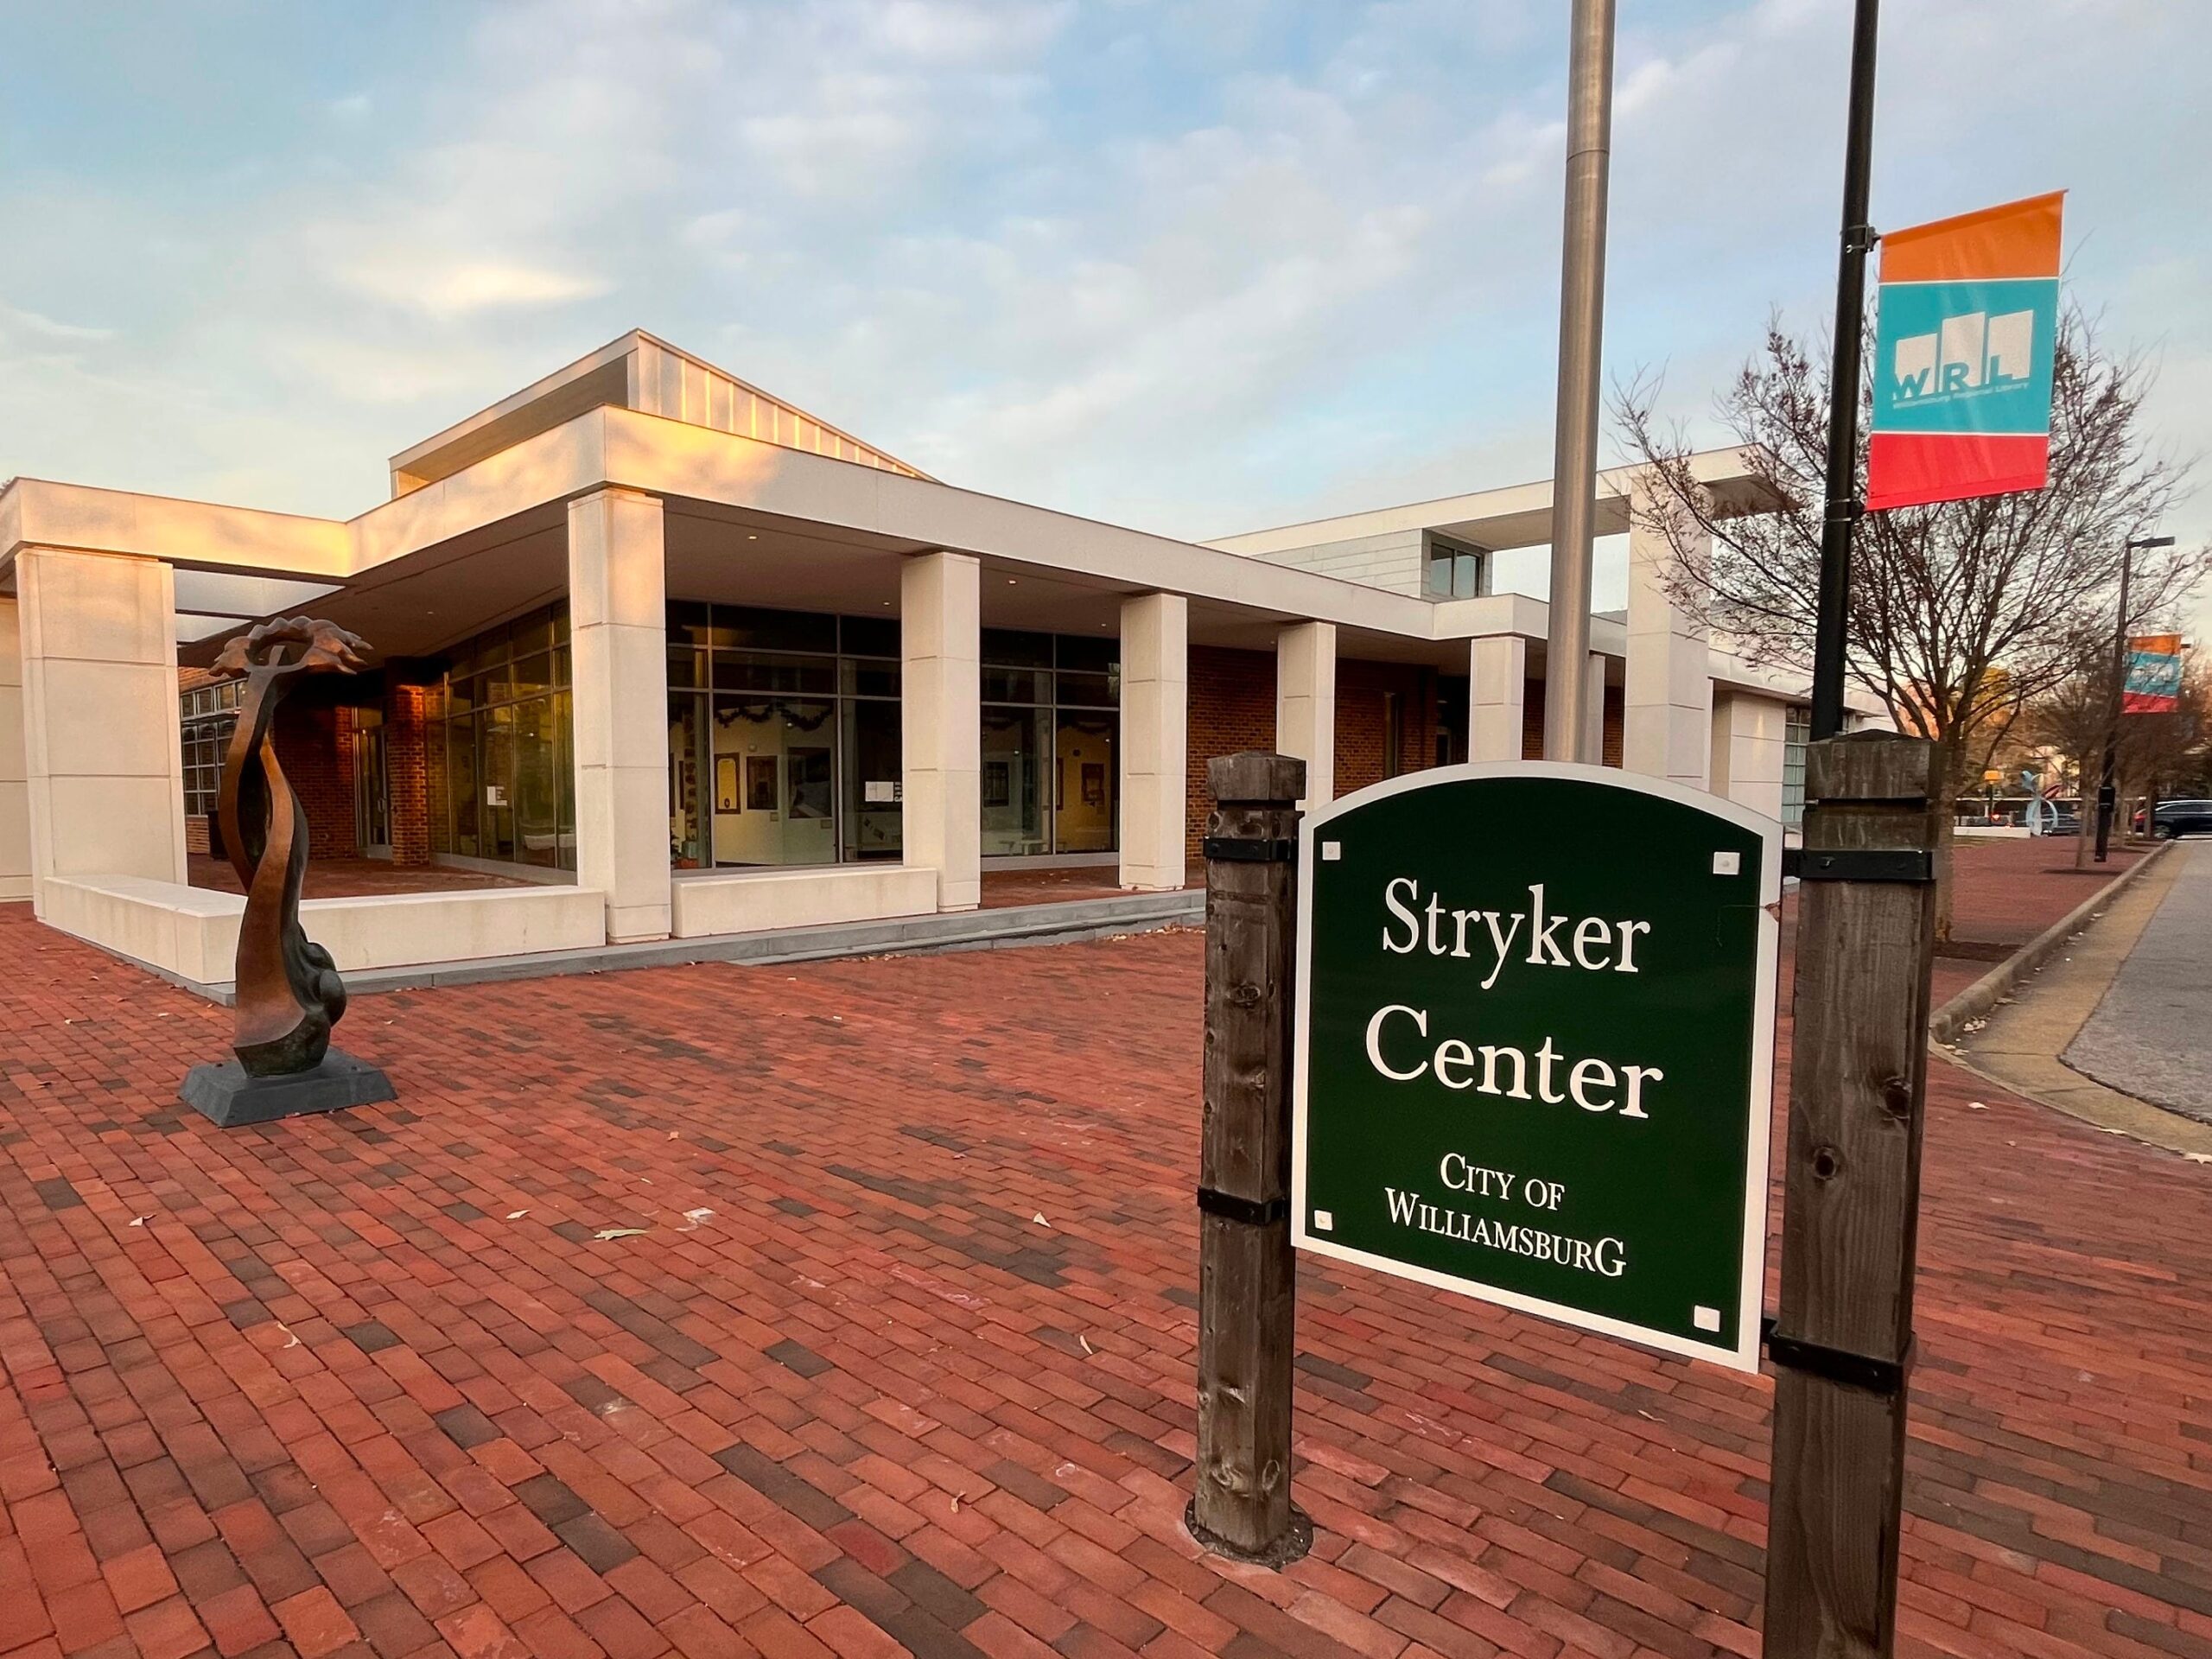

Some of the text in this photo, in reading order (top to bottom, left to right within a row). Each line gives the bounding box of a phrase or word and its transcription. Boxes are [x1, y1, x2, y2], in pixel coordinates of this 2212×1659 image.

[1891, 354, 2014, 400] WRL
[1382, 877, 1651, 990] Stryker
[1365, 1004, 1664, 1119] Center
[1440, 1152, 1566, 1211] CITY OF
[1384, 1186, 1627, 1277] WILLIAMSBURG
